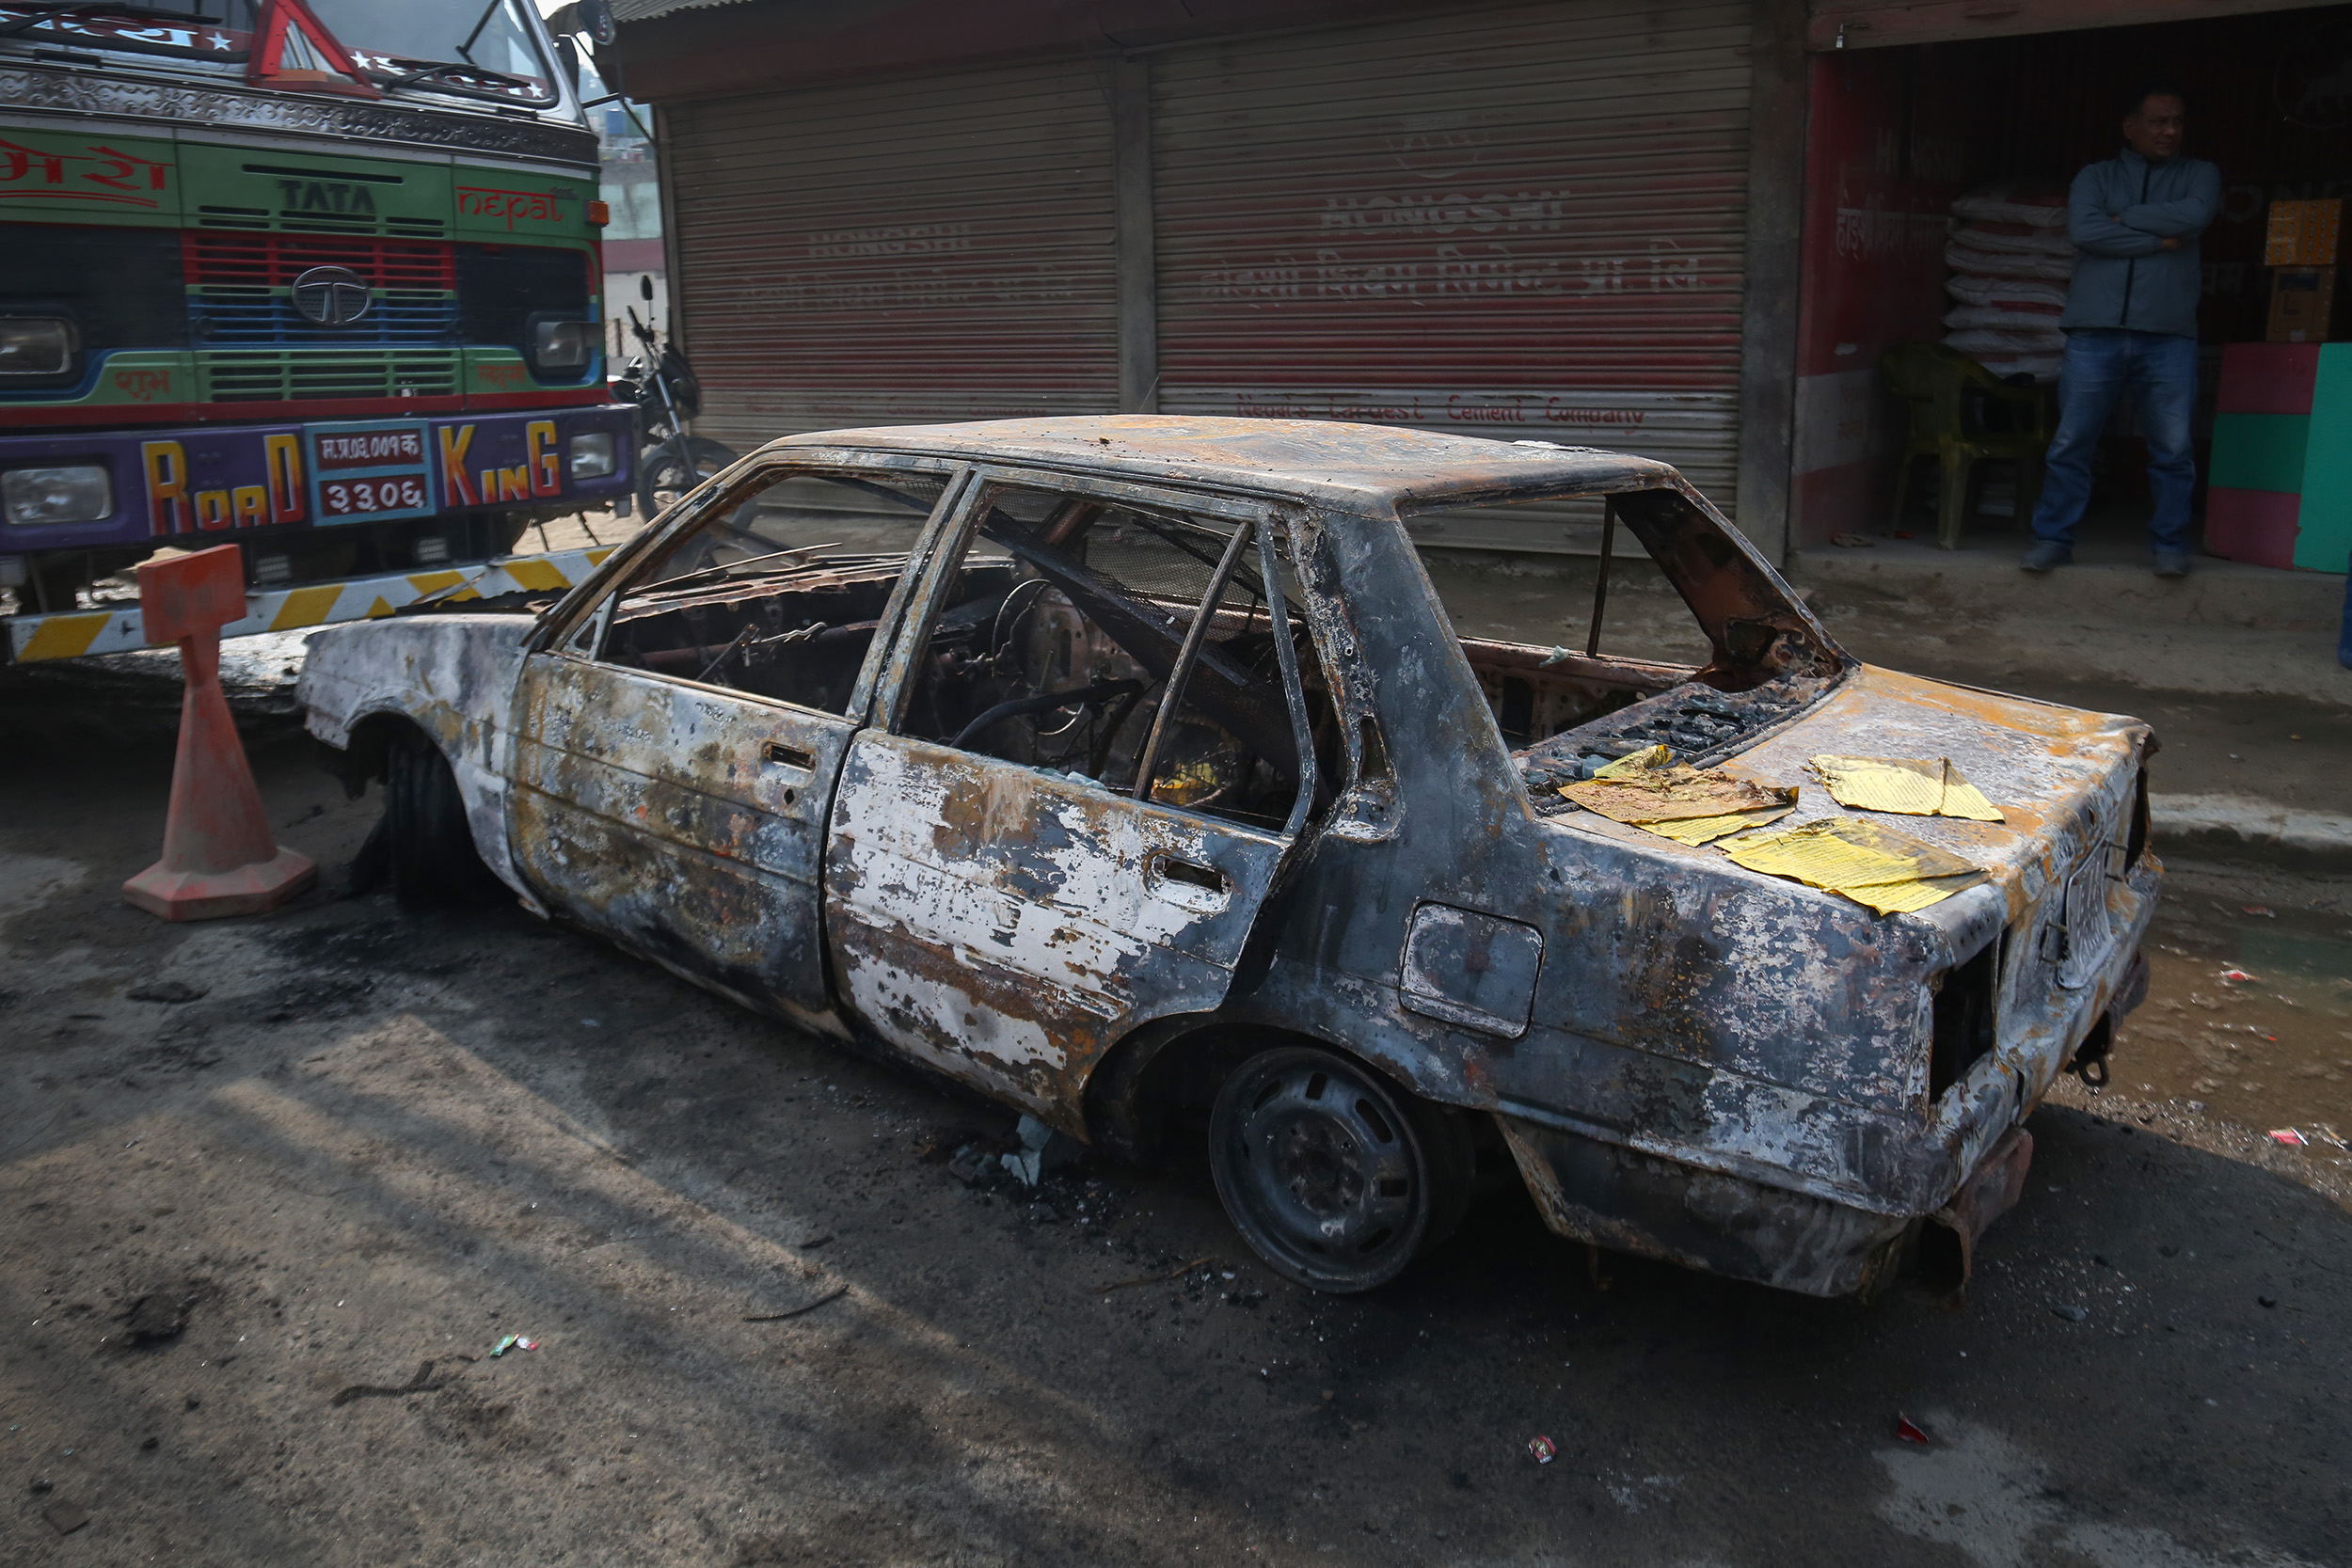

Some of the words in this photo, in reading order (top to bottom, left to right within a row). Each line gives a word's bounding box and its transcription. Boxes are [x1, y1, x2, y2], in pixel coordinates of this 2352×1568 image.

[276, 179, 376, 214] TATA
[1319, 190, 1570, 237] HONGSHI
[809, 225, 970, 259] HONGSHI
[1448, 395, 1526, 422] Cement
[1546, 396, 1646, 435] Company
[326, 481, 425, 514] ३३०६
